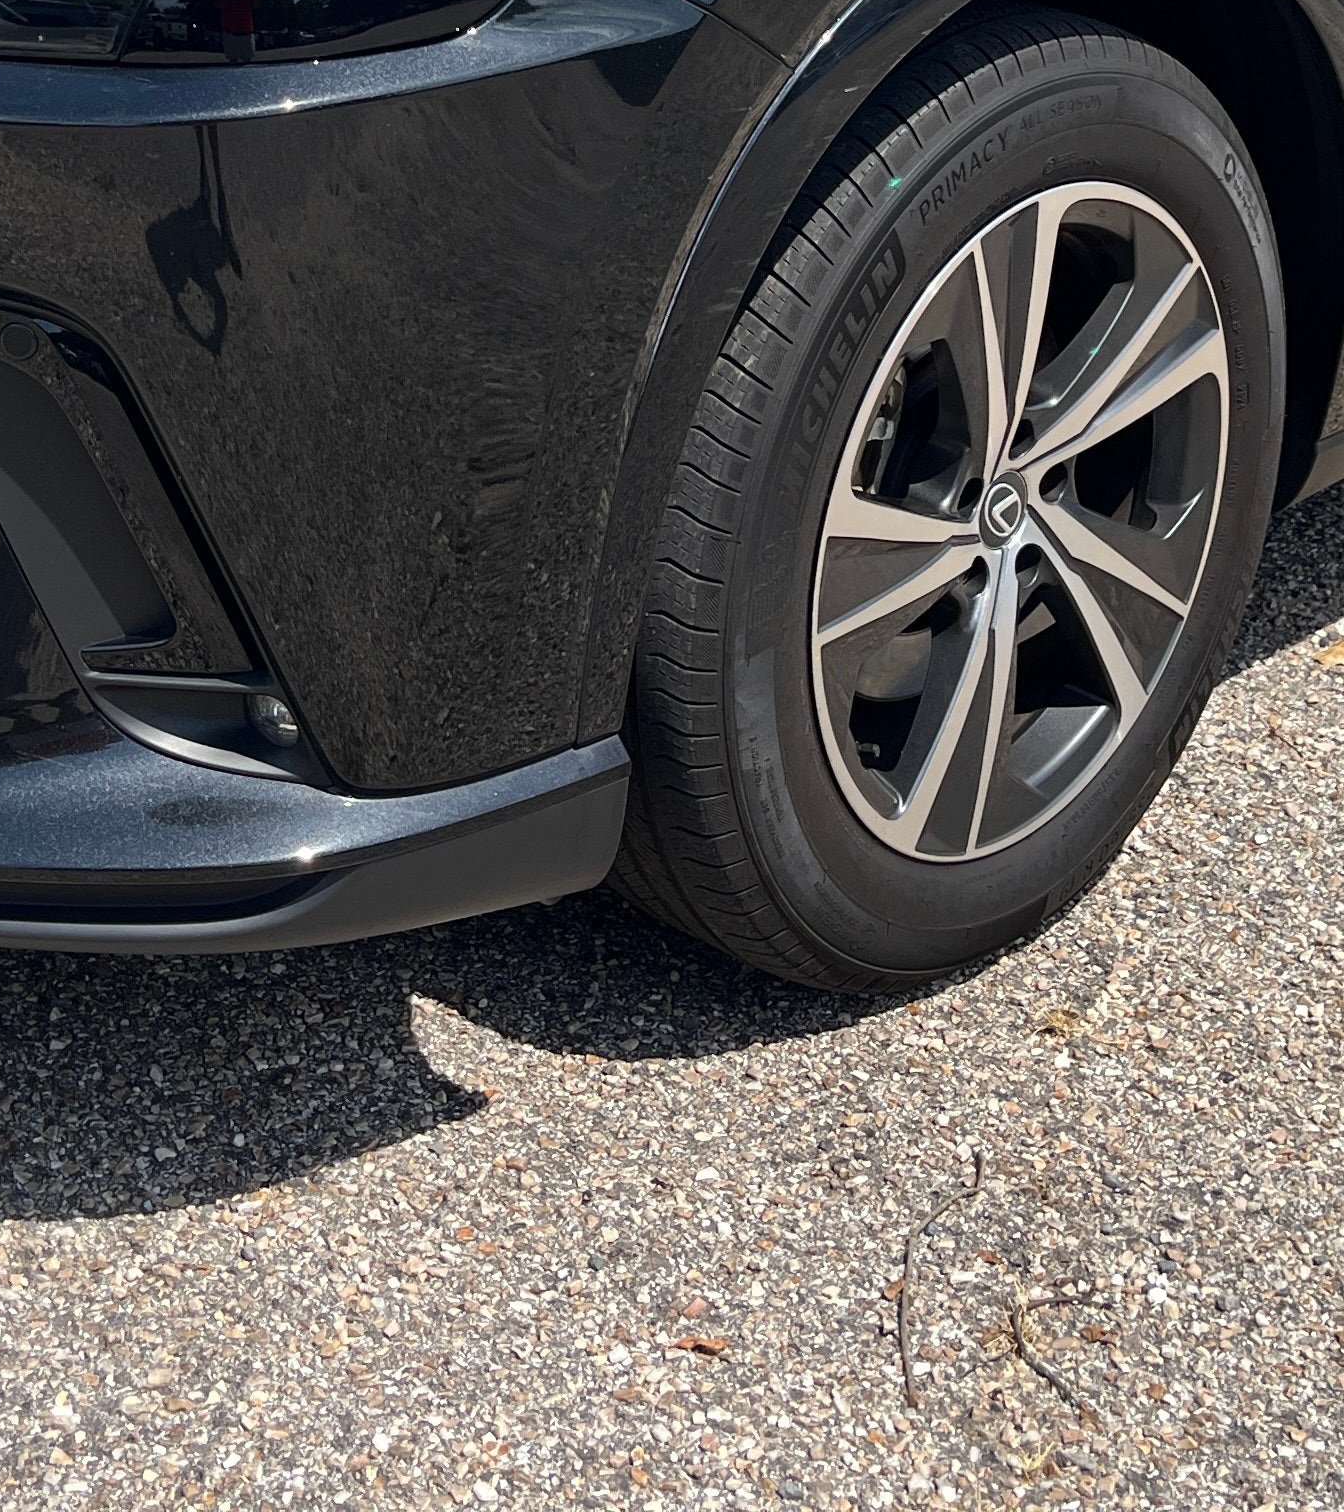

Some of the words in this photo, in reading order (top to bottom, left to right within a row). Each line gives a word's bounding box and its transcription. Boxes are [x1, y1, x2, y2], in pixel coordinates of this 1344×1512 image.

[919, 127, 1010, 226] PRIMACY
[1019, 113, 1042, 131] ALL
[1048, 95, 1104, 119] SEASON
[775, 246, 901, 512] MICHELIN
